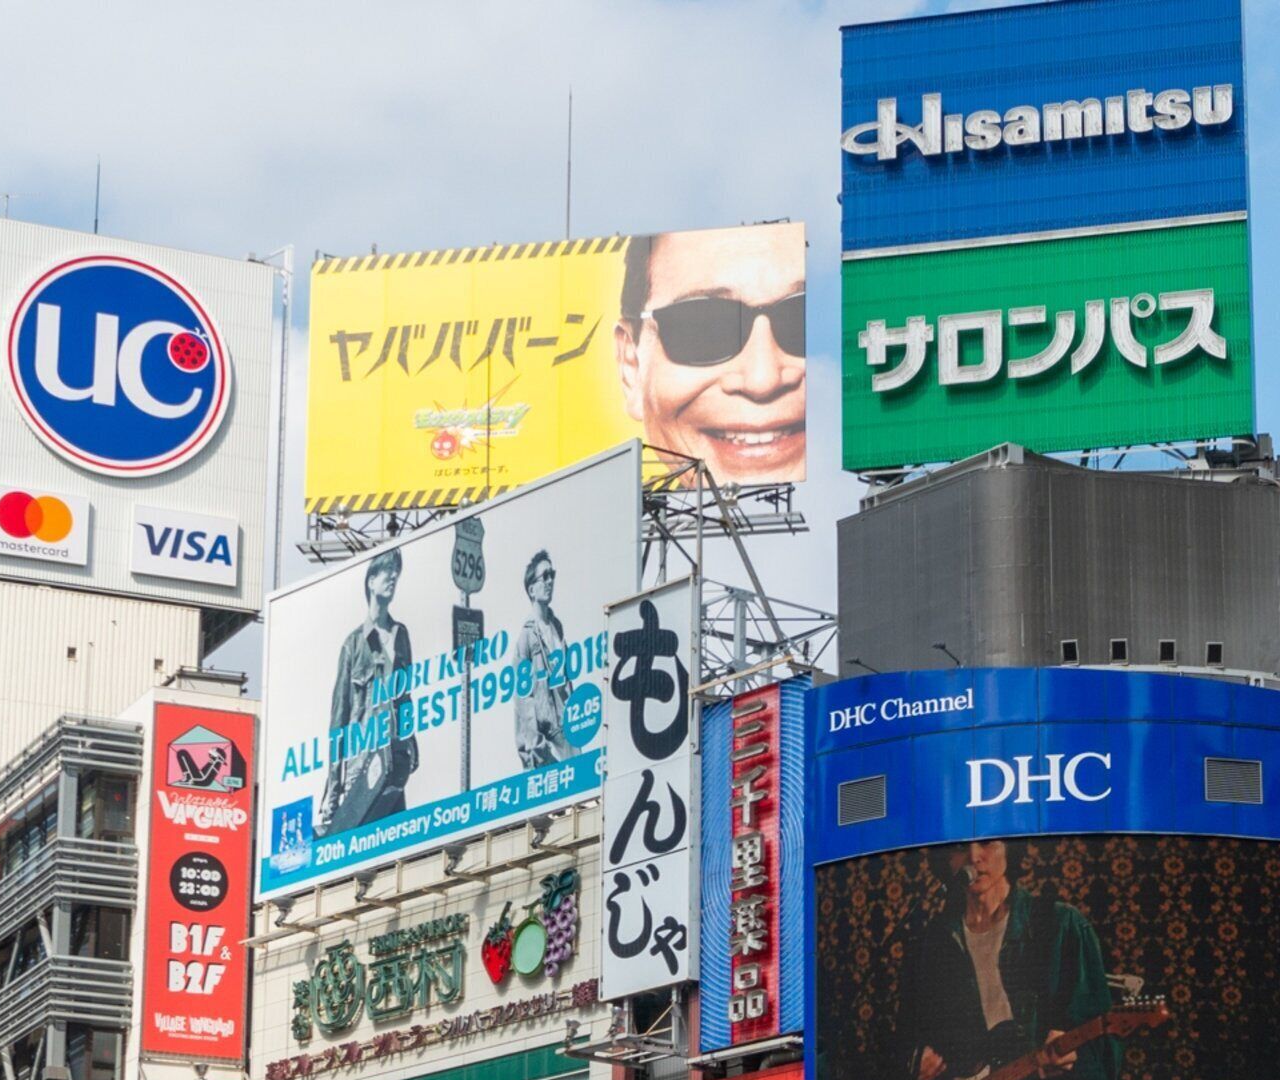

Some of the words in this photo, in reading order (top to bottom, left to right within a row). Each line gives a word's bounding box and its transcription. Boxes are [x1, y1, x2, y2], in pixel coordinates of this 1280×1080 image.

[840, 83, 1234, 161] Hisamitsu
[328, 312, 605, 383] ヤバババーン
[858, 287, 1227, 393] サロンパス
[433, 464, 511, 480] はじまってまーす。
[136, 522, 233, 567] VISA
[455, 550, 483, 582] 5296
[371, 628, 510, 710] KOBUKURO
[281, 735, 324, 783] ALL
[328, 707, 392, 765] TIME
[398, 683, 464, 742] BEST
[566, 696, 601, 722] 12.05
[829, 701, 878, 733] DHC
[880, 687, 975, 723] Channel
[606, 598, 690, 977] もんじゃ
[965, 751, 1113, 808] DHC
[314, 840, 346, 866] 20th
[348, 814, 432, 857] Anniversary
[432, 803, 471, 831] Song
[727, 699, 769, 1024] 三千里薬品
[170, 921, 226, 956] B1F
[167, 958, 227, 995] B2F
